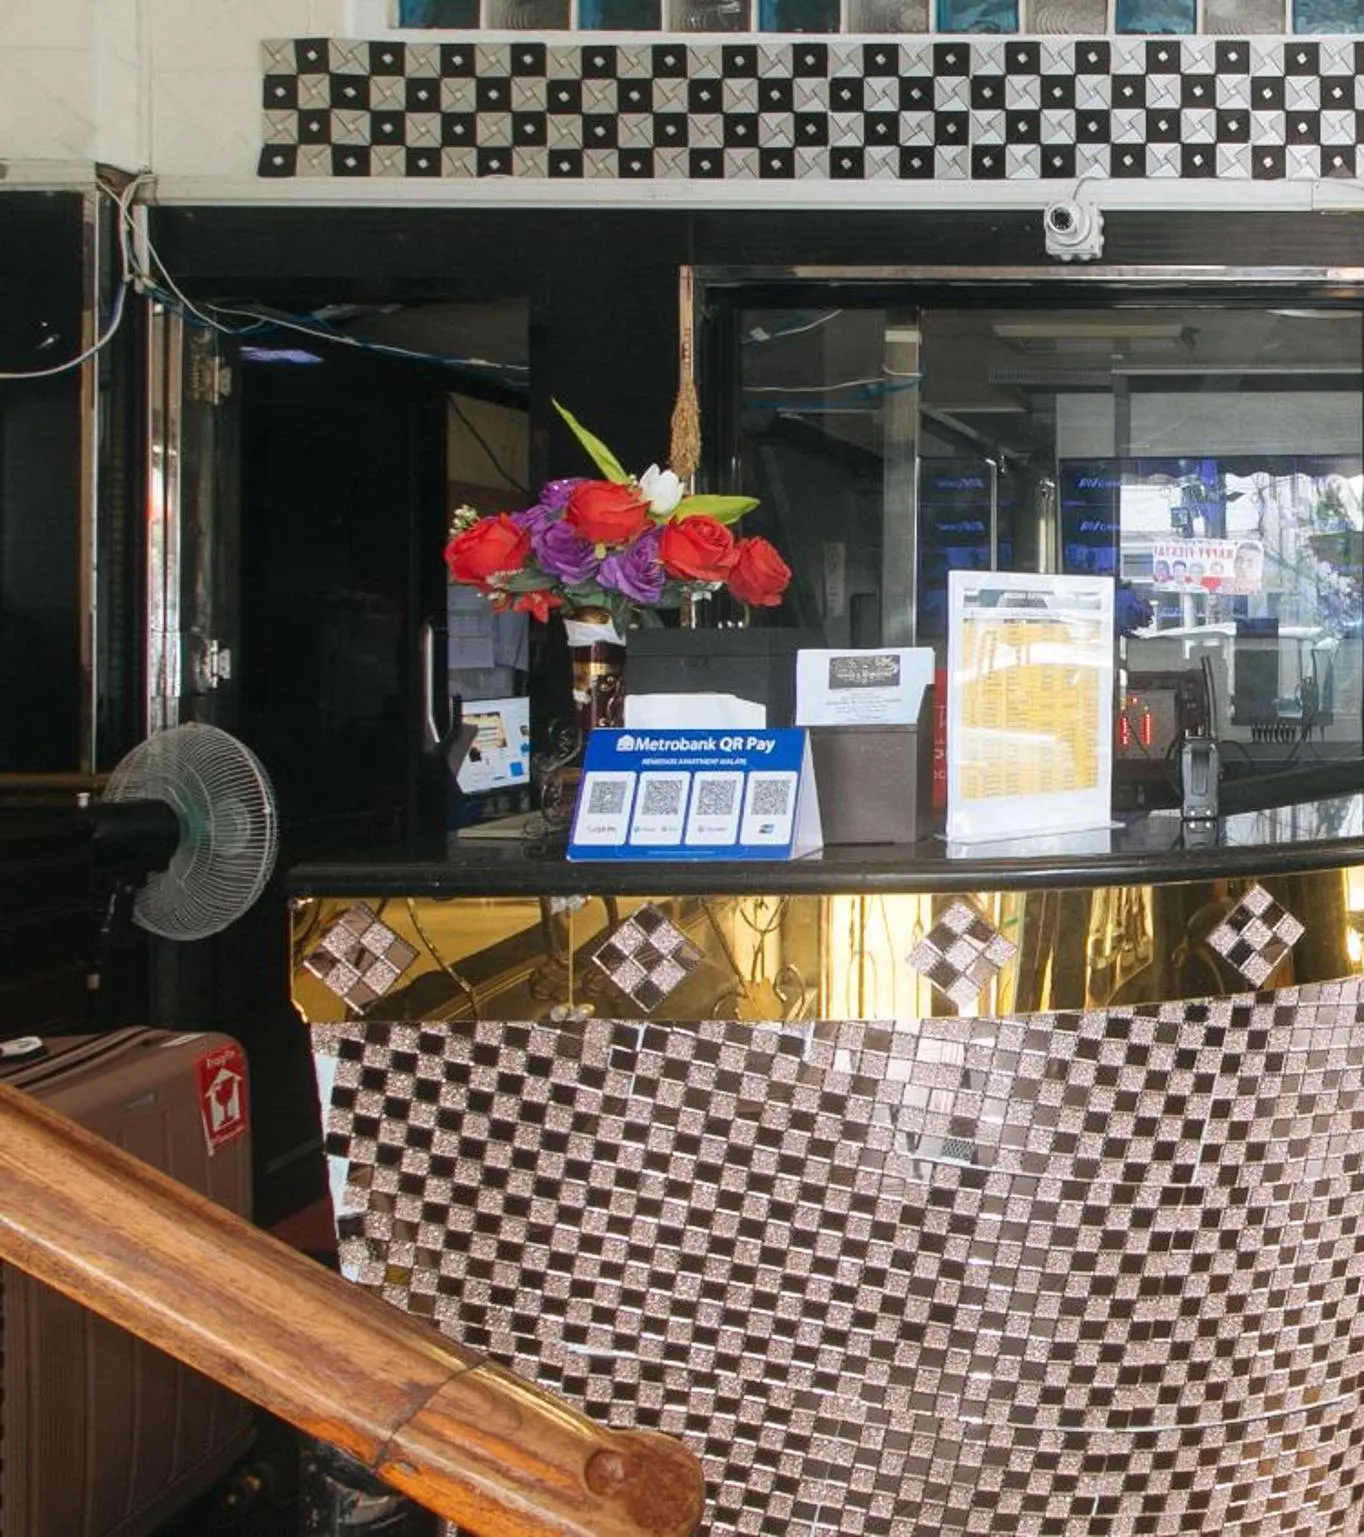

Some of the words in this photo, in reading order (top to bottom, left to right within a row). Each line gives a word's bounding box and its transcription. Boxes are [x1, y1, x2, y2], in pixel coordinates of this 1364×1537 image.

[635, 736, 716, 751] Metrobank
[719, 737, 743, 752] QR
[746, 737, 775, 754] Pay
